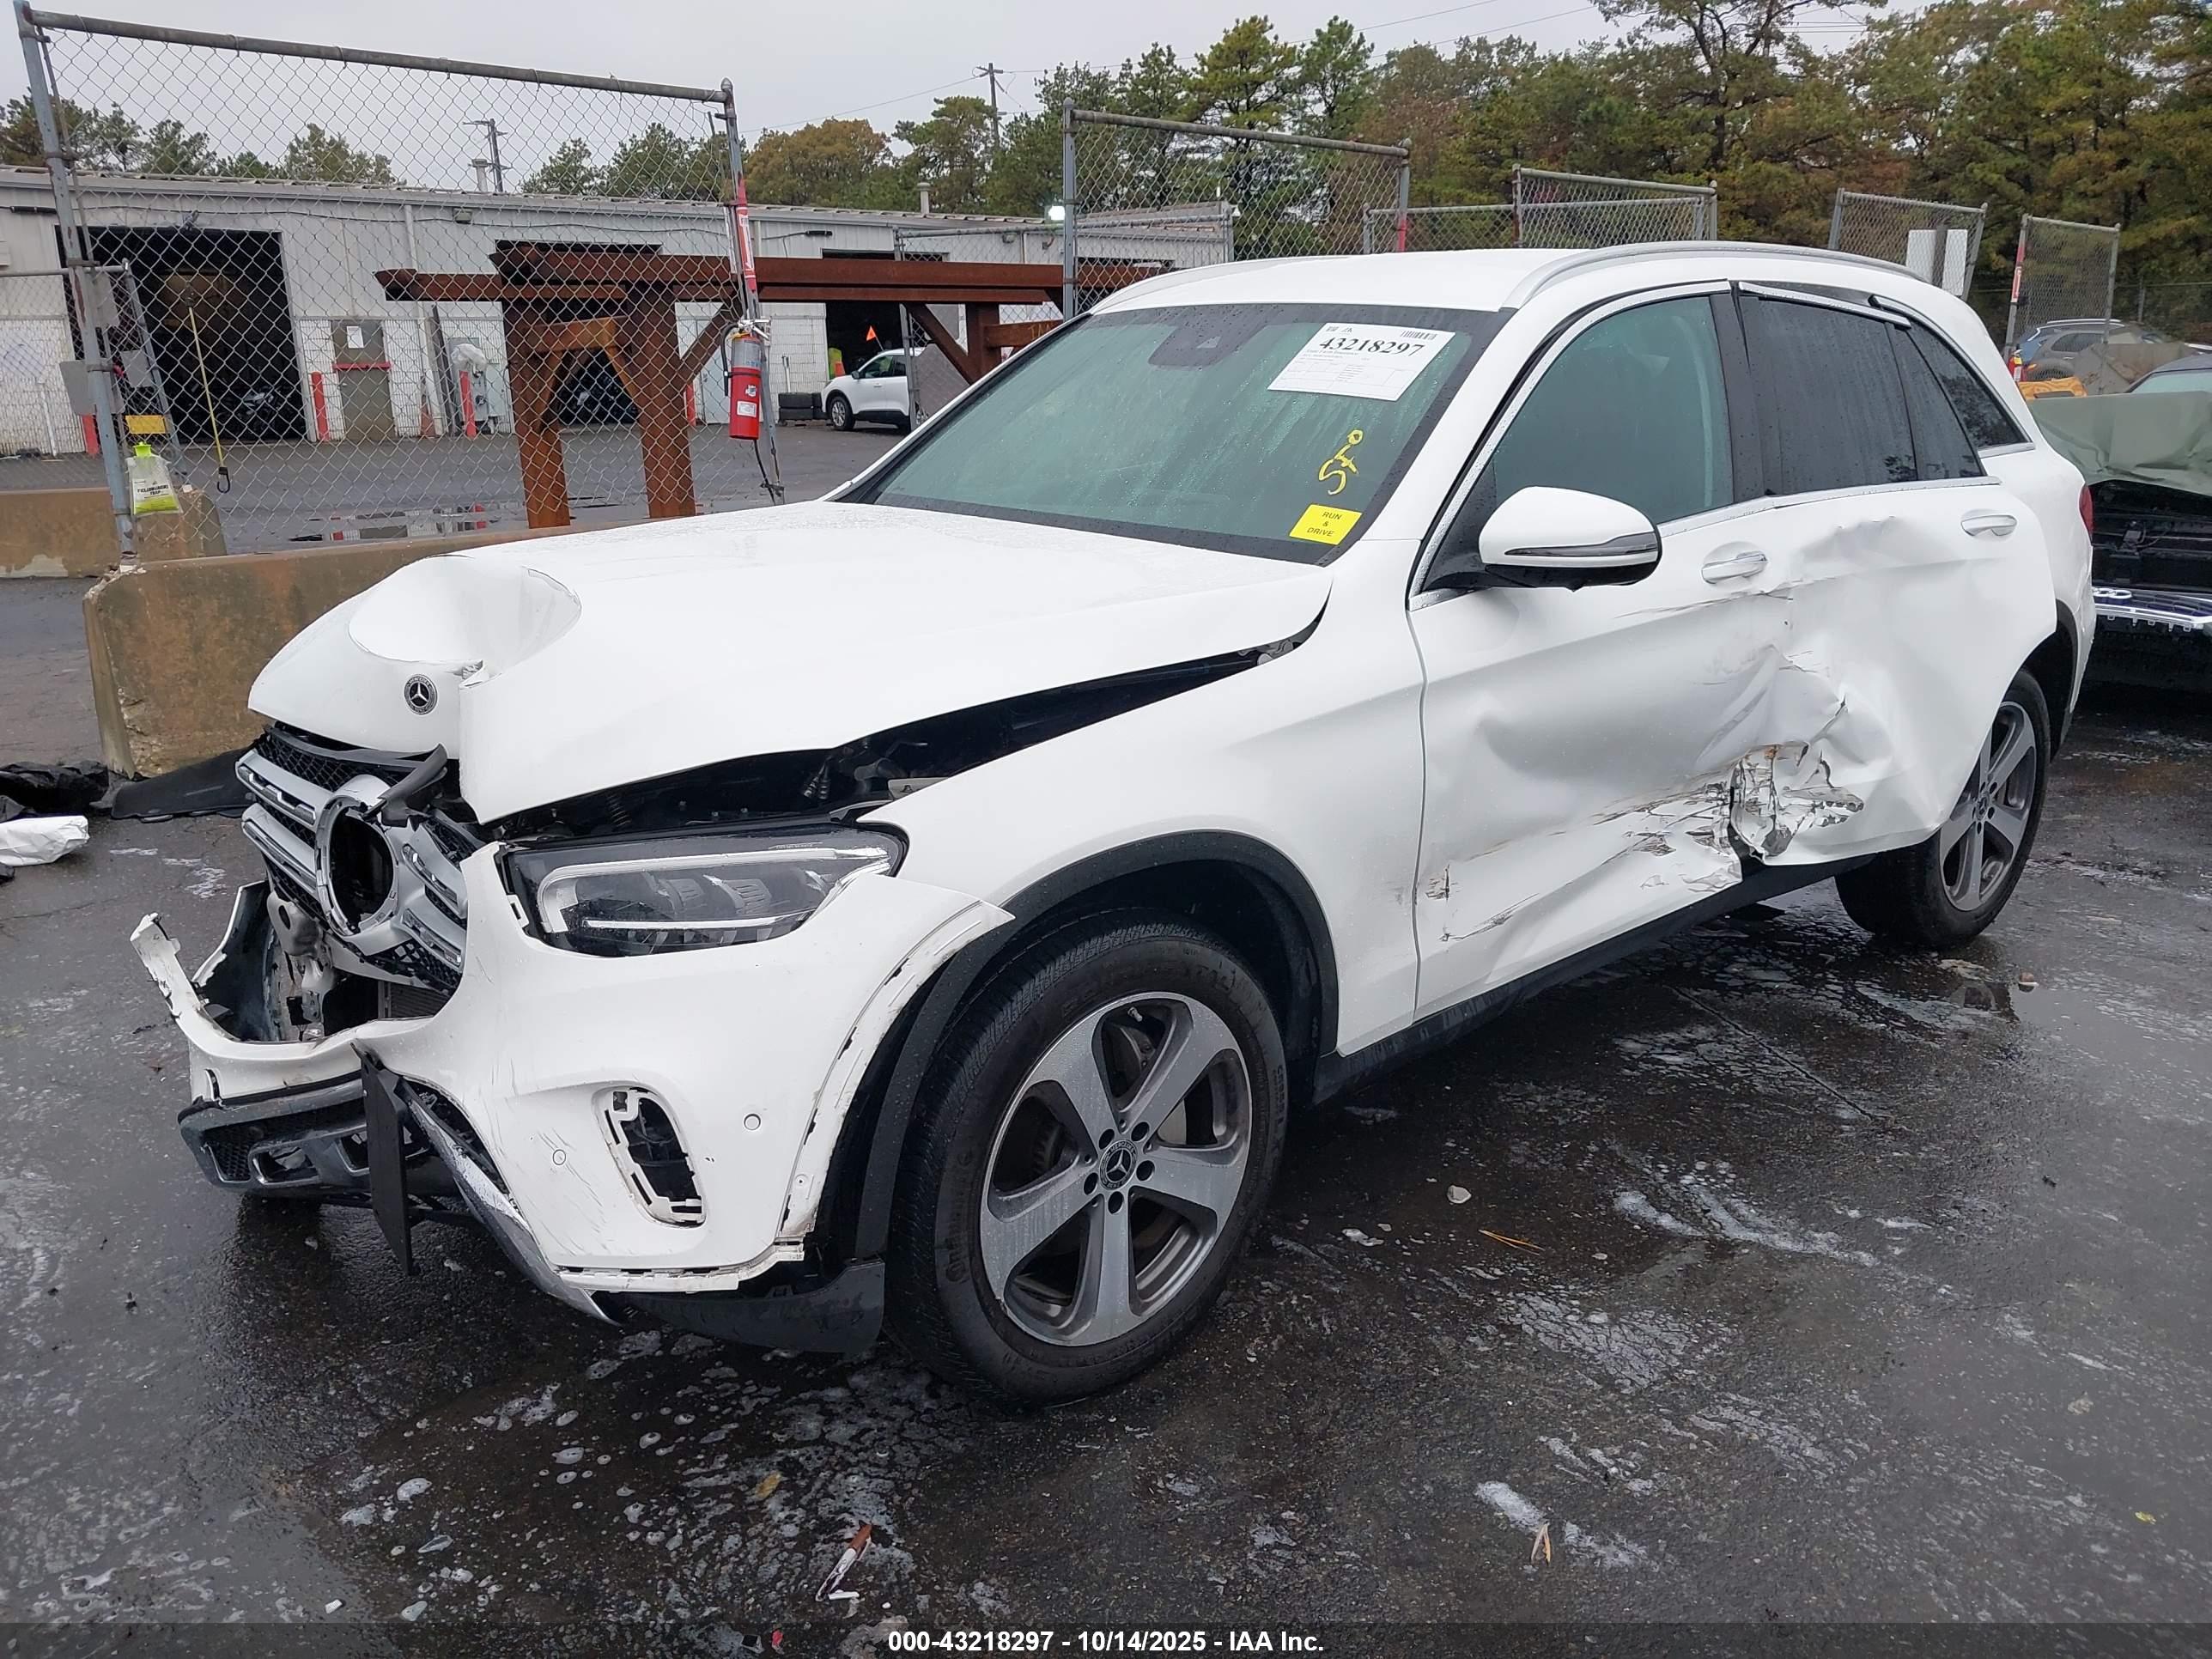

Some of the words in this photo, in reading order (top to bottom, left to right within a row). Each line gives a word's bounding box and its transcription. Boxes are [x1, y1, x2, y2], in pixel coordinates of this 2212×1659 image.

[1319, 337, 1425, 356] 43218297
[1322, 511, 1343, 520] RUN
[1306, 527, 1335, 537] DRIVE
